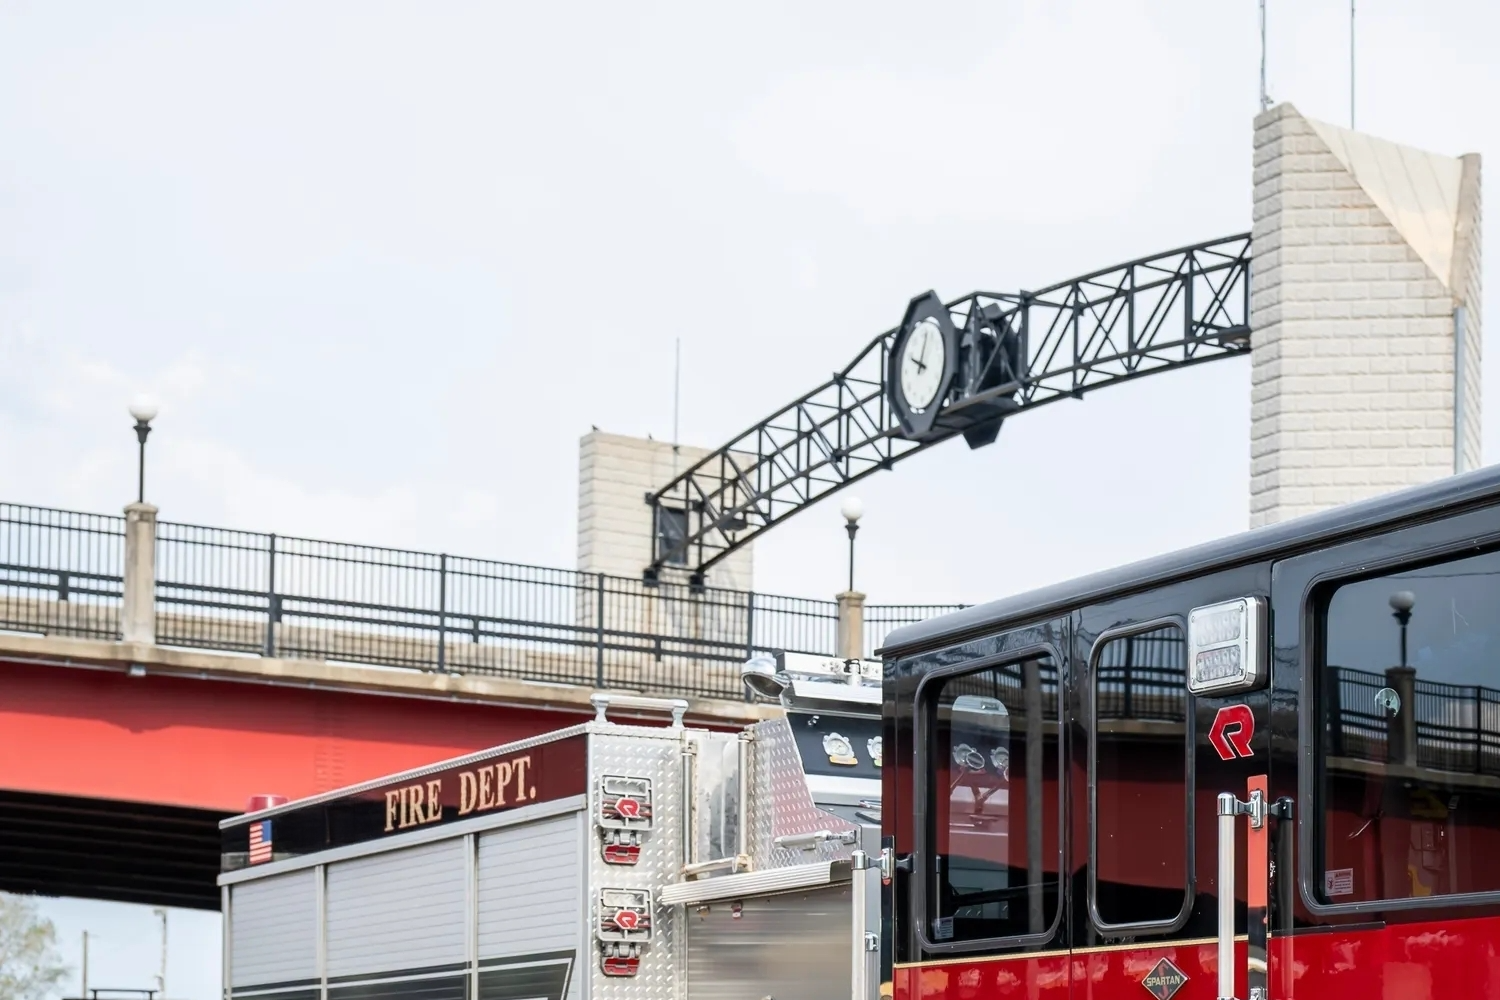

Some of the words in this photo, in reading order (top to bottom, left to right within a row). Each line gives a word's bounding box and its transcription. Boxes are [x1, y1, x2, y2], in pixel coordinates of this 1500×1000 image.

[384, 778, 443, 832] FIRE
[457, 755, 537, 816] DEPT.
[1146, 974, 1181, 987] SPARTAN
